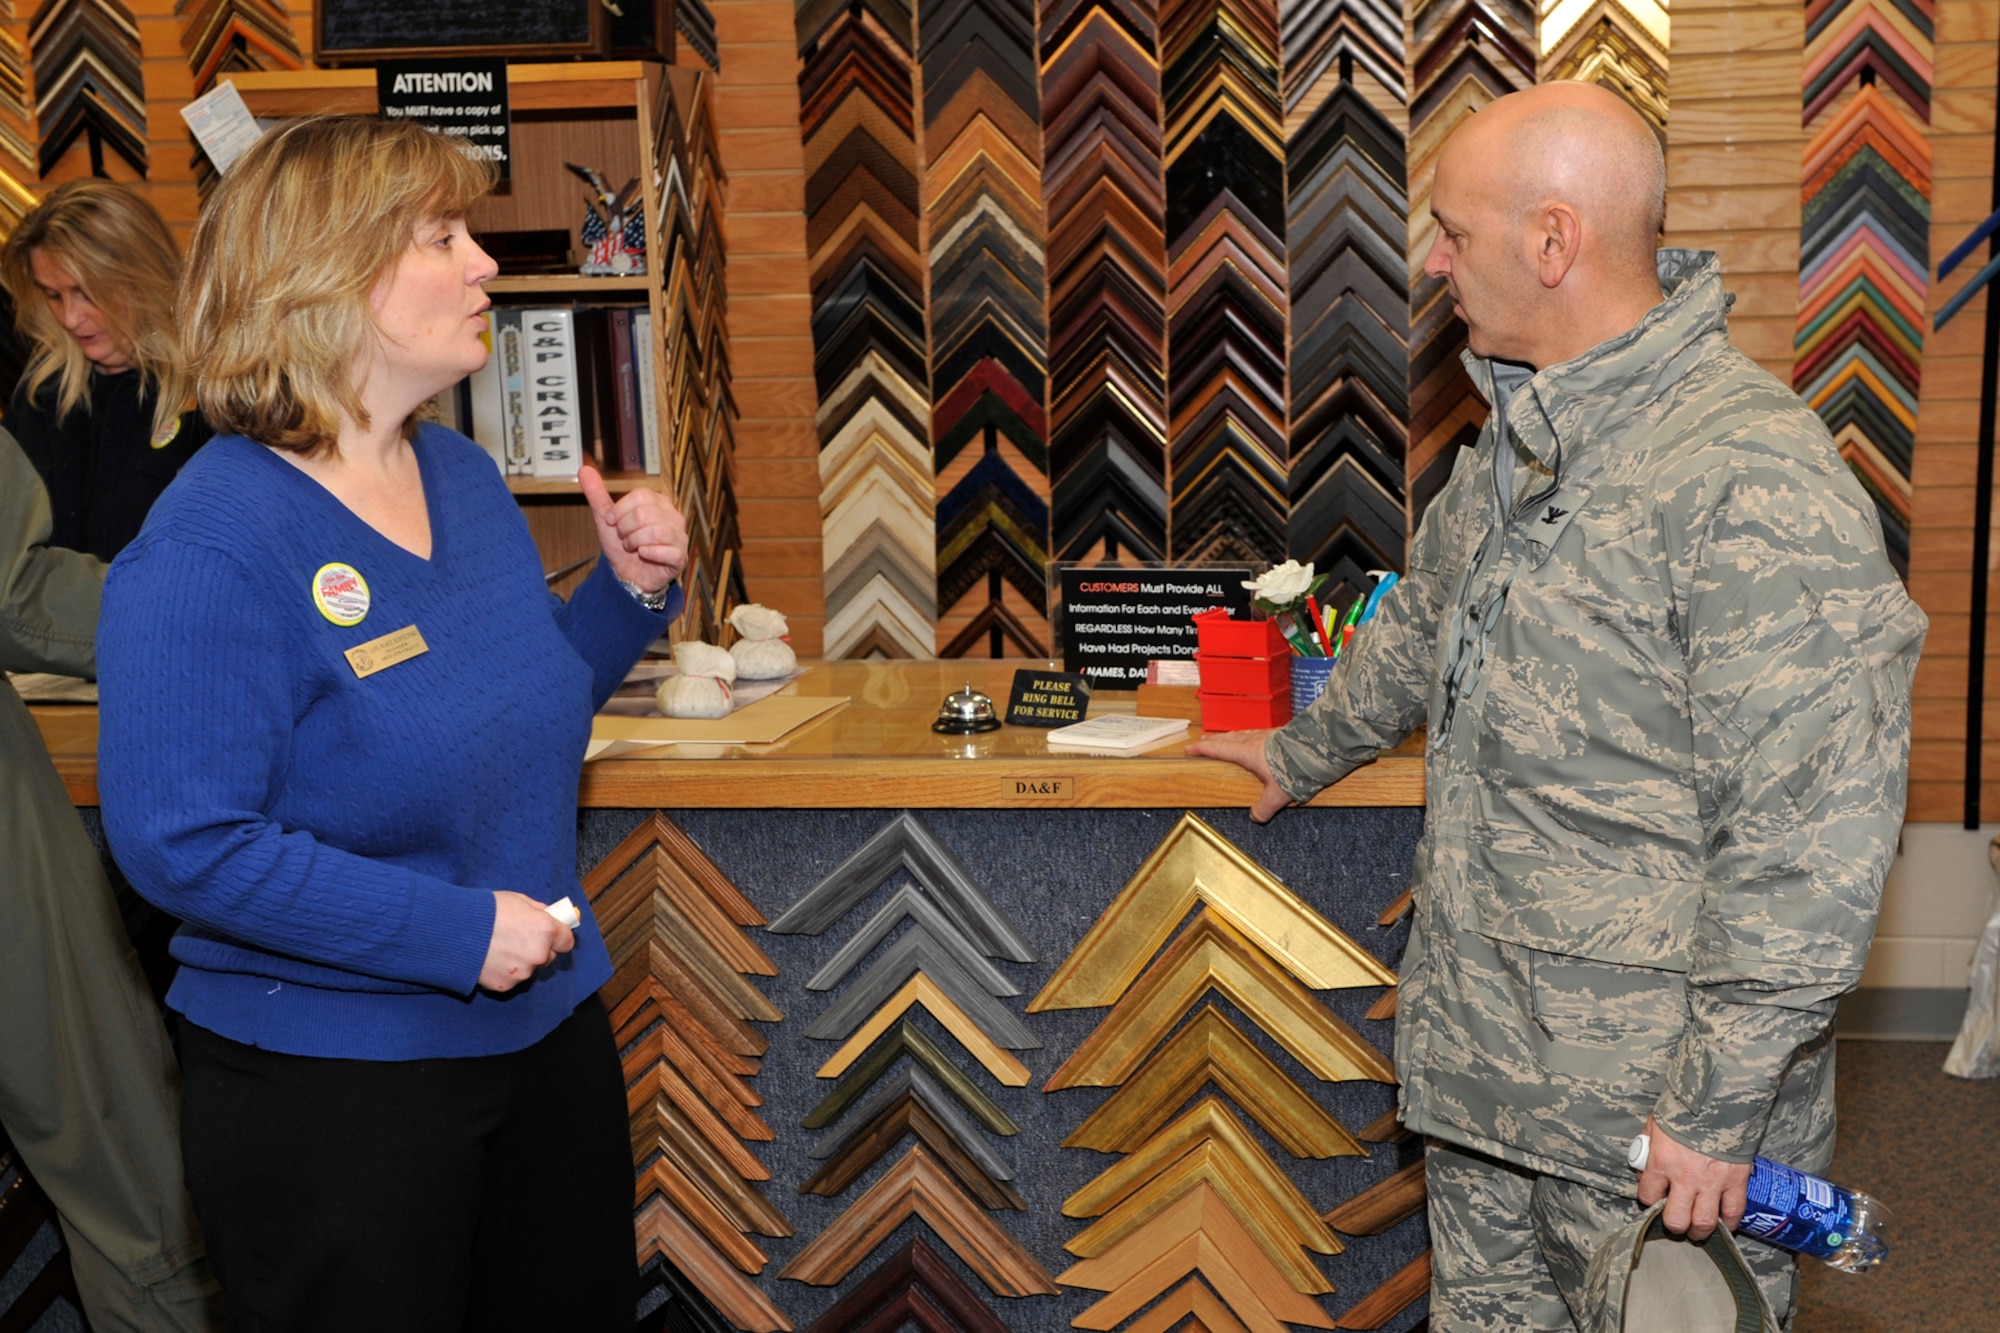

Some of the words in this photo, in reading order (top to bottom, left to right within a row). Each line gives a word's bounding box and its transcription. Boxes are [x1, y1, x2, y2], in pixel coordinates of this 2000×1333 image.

[392, 71, 493, 94] ATTENTION
[386, 106, 403, 117] You
[404, 105, 429, 117] MUST
[430, 105, 454, 116] have
[455, 106, 463, 116] a
[464, 105, 489, 118] copy
[490, 104, 502, 116] of
[469, 124, 491, 137] pick
[491, 125, 506, 137] up
[536, 375, 571, 461] CRAFTS
[320, 576, 359, 598] FAMILY
[1079, 582, 1139, 593] CUSTOMERS
[1140, 583, 1164, 594] Must
[1166, 583, 1205, 595] Provide
[1205, 584, 1225, 595] ALL
[1069, 603, 1121, 615] Information
[1121, 604, 1136, 615] For
[1136, 604, 1161, 615] Each
[1161, 605, 1182, 616] and
[1075, 623, 1133, 634] REGARDLESS
[1134, 624, 1156, 635] How
[1156, 625, 1184, 637] Many
[1079, 642, 1107, 654] Have
[1107, 643, 1131, 655] Had
[1131, 644, 1172, 657] Projects
[1086, 666, 1127, 679] NAMES,
[1128, 667, 1149, 679] DAT
[1032, 679, 1072, 693] PLEASE
[1022, 692, 1048, 705] RING
[1049, 694, 1076, 707] BELL
[1013, 704, 1035, 717] FOR
[1035, 706, 1079, 720] SERVICE
[1015, 781, 1062, 794] DA&F
